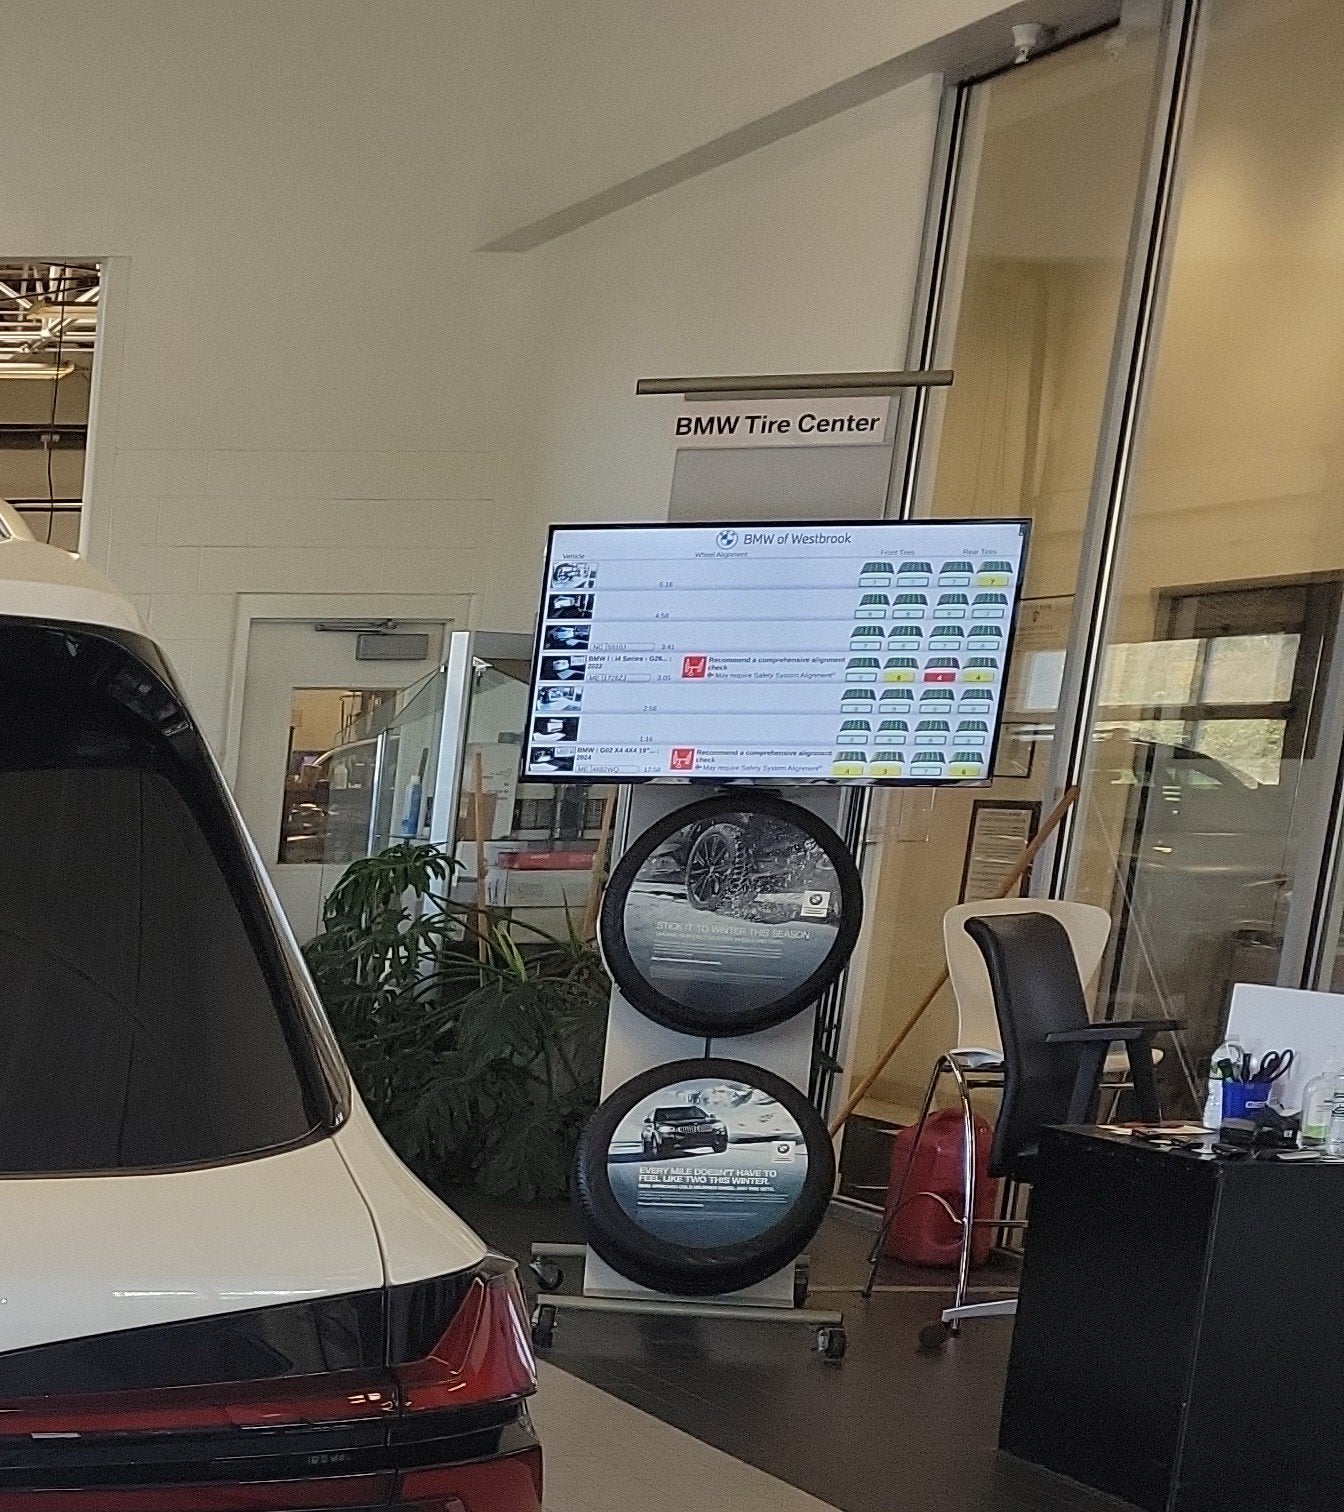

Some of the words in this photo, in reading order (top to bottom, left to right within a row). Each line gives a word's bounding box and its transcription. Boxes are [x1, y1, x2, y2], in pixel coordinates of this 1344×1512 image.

[675, 415, 740, 436] BMW
[745, 414, 791, 434] Tire
[797, 413, 881, 433] Center
[743, 533, 775, 545] BMW
[777, 533, 789, 545] of
[791, 532, 852, 544] Westbrook
[811, 657, 846, 665] alignment
[639, 1166, 669, 1174] EVERY
[670, 1167, 693, 1175] MILE
[694, 1168, 734, 1176] DOESN'T
[736, 1169, 762, 1177] HAVE
[764, 1169, 777, 1178] TO
[638, 1174, 662, 1182] FEEL
[662, 1175, 683, 1183] LIKE
[685, 1175, 707, 1184] TWO
[708, 1176, 731, 1184] THIS
